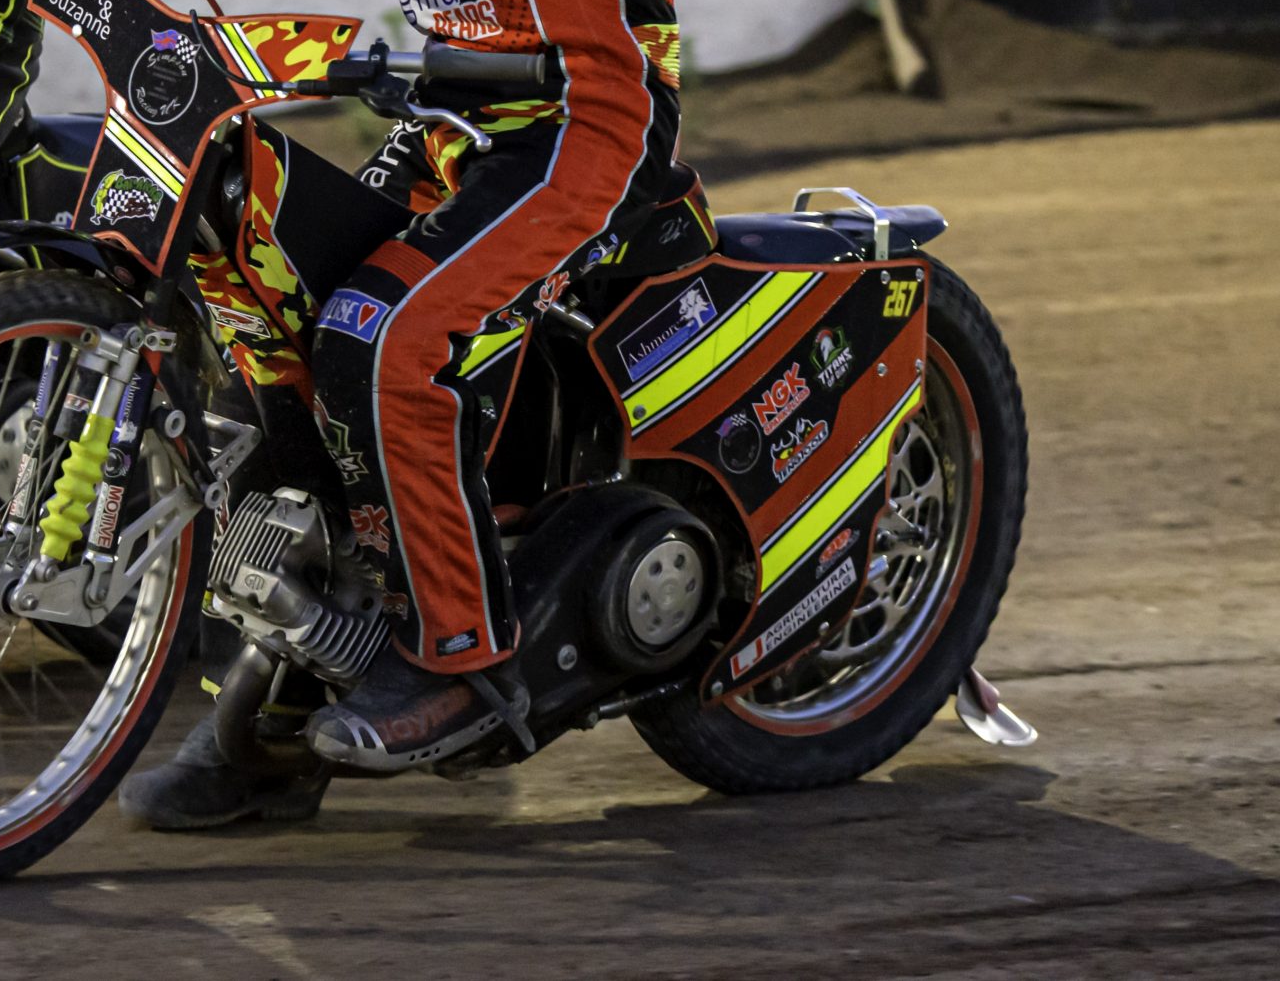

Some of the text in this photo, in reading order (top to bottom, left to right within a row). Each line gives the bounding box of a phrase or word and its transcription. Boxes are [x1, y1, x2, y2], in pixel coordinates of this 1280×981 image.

[752, 361, 807, 427] NGK
[98, 485, 125, 550] MOTIVE
[765, 561, 853, 642] AGRICULTURAL
[765, 575, 853, 652] ENGINEERING
